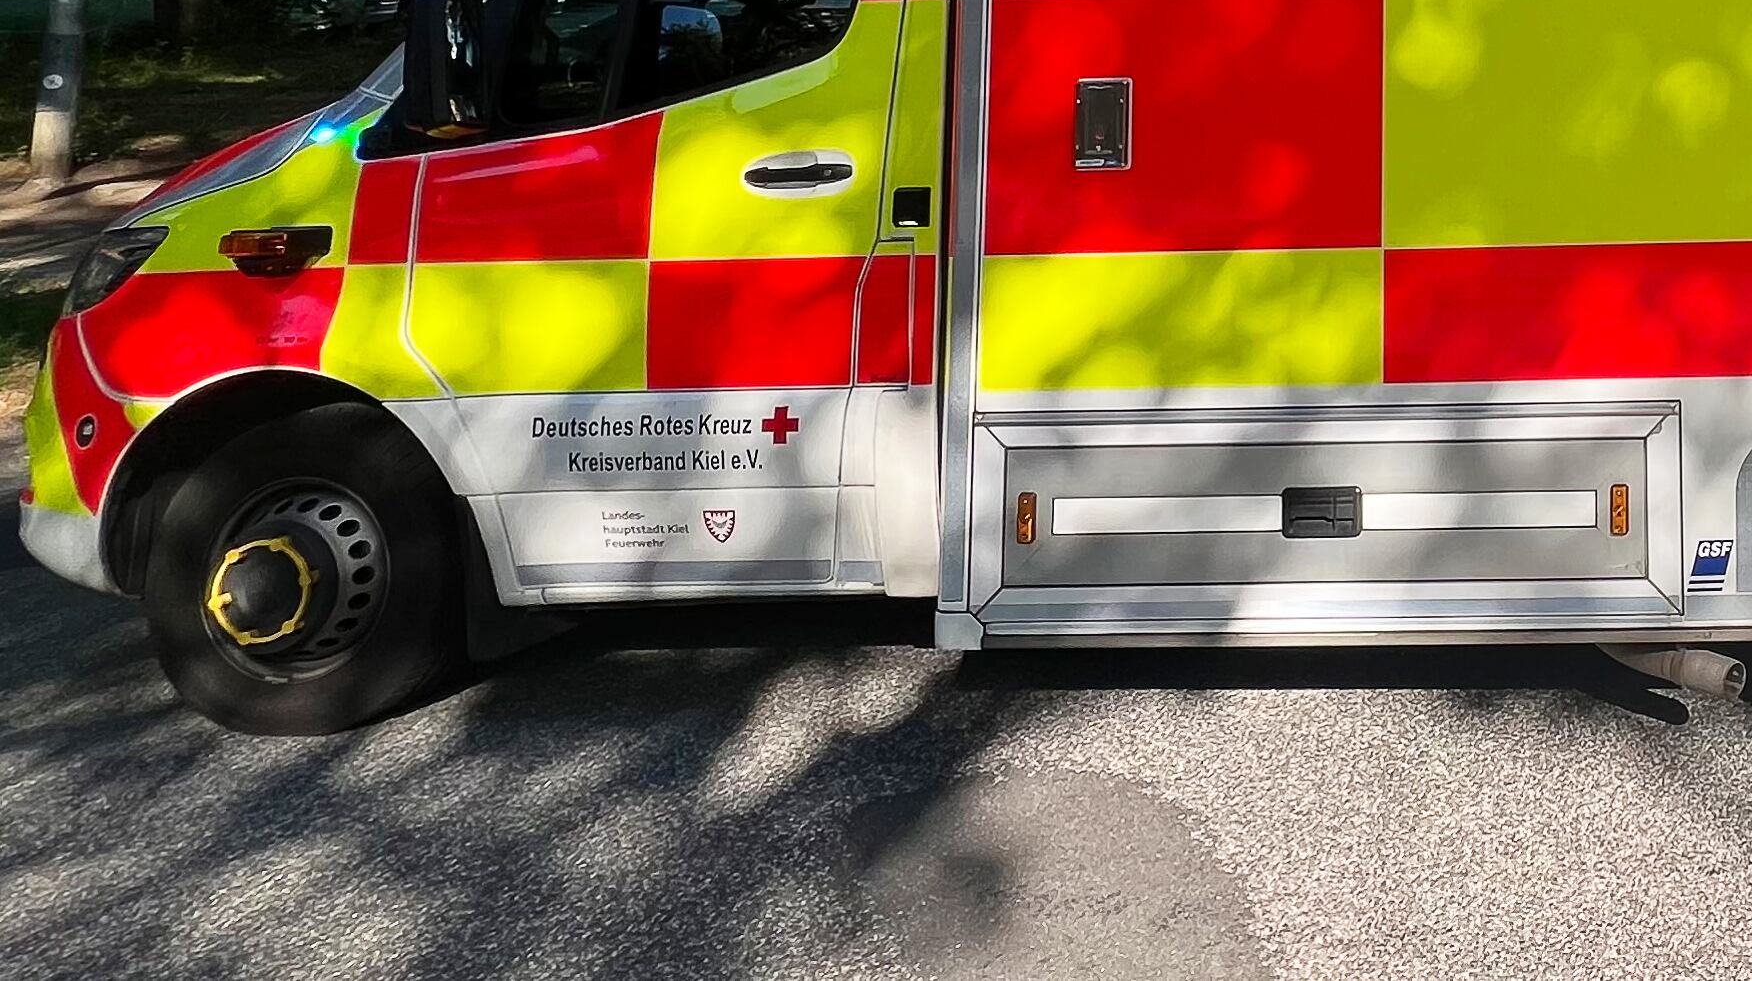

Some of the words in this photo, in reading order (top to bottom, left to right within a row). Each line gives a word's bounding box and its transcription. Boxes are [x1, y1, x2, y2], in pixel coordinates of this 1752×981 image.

[532, 416, 634, 438] Deutsches
[639, 414, 695, 435] Rotes
[699, 414, 752, 435] Kreuz
[568, 451, 687, 472] Kreisverband
[692, 449, 726, 470] Kiel
[731, 449, 763, 469] e.V.
[602, 511, 646, 520] Landes-
[667, 523, 690, 534] Kiel
[605, 539, 665, 548] Feuerwehr
[1698, 541, 1732, 558] GSF
